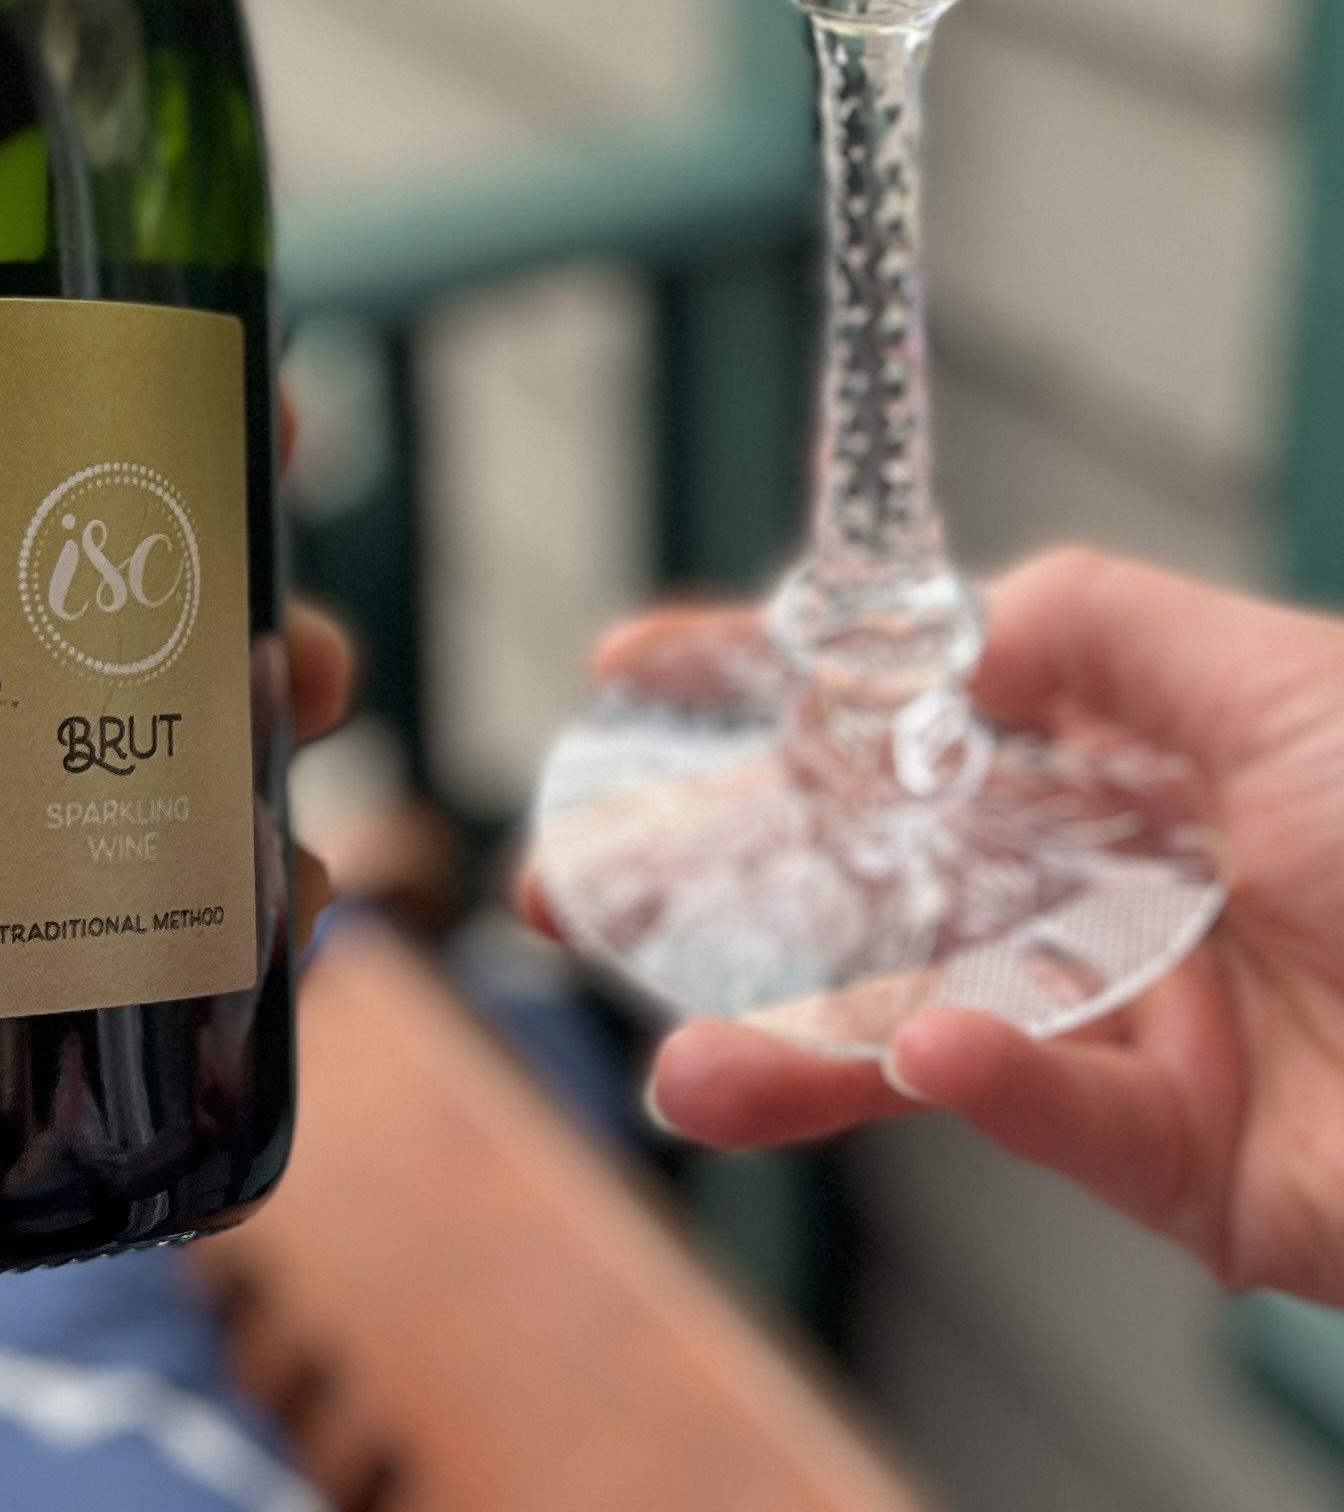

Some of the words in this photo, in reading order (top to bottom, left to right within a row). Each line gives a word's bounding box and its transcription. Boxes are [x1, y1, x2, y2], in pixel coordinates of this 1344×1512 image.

[48, 513, 185, 621] isc
[57, 713, 183, 776] BRUT
[45, 795, 190, 830] SPARKLING
[87, 833, 159, 863] WINE
[152, 906, 225, 931] METHOD
